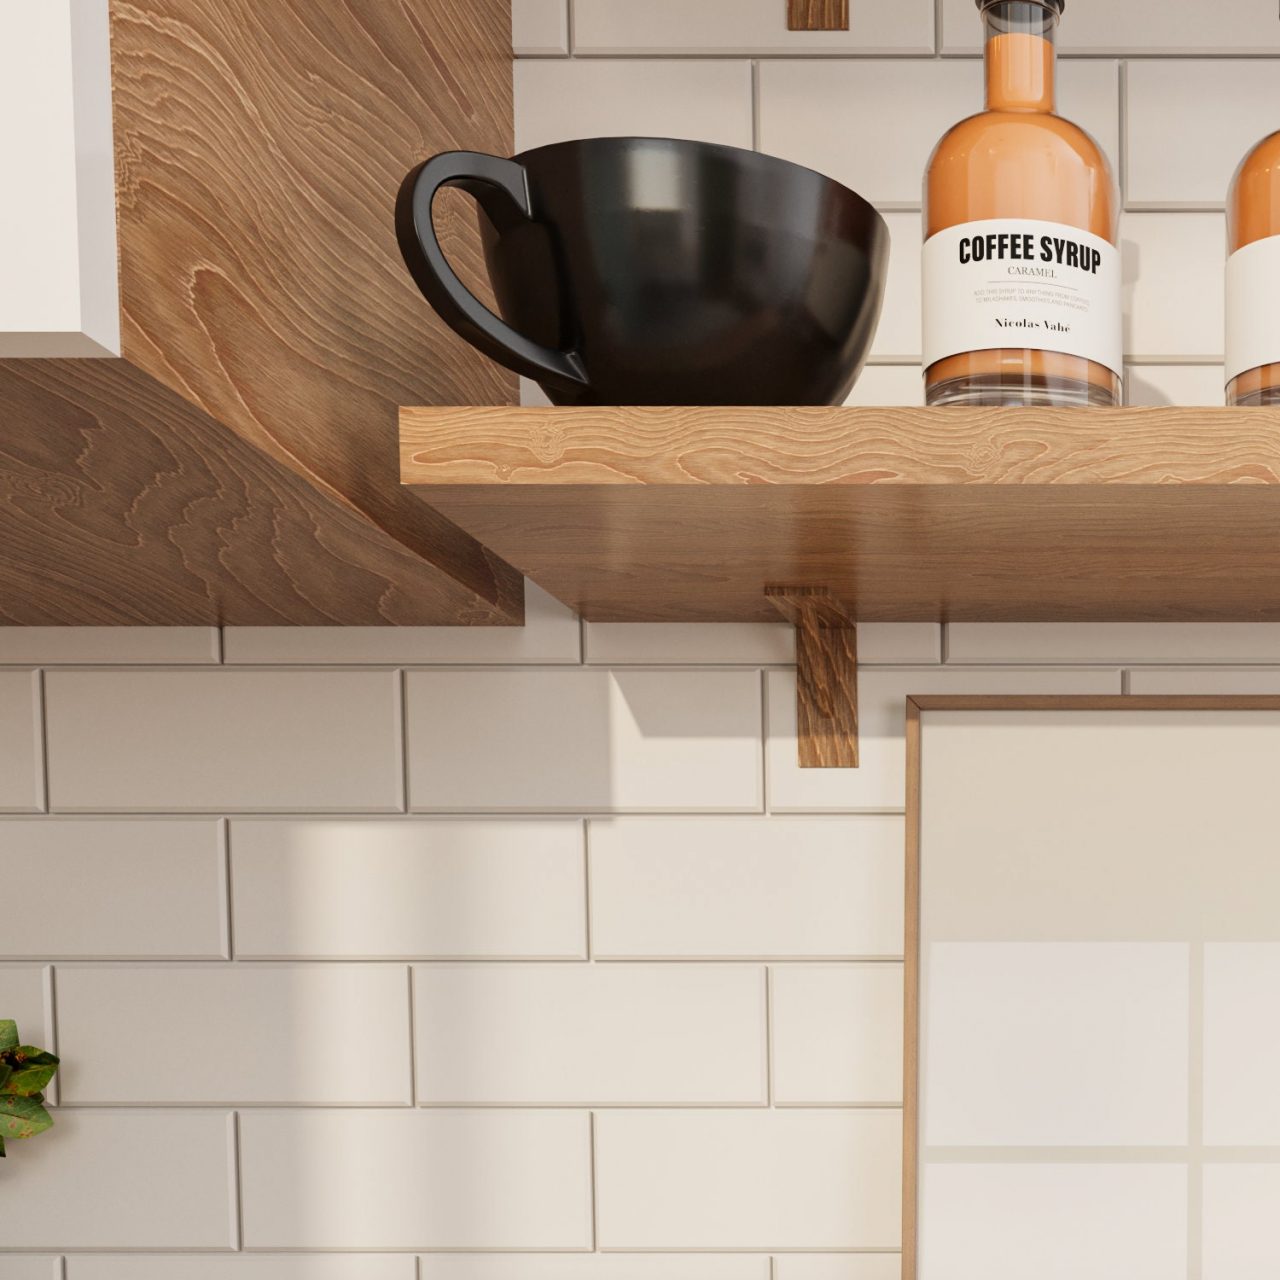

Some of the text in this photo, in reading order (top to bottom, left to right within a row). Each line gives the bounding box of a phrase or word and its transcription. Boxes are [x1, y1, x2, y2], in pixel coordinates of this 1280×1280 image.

[959, 234, 1101, 275] COFFEE SYRUP
[1007, 266, 1057, 279] CARAMEL
[995, 318, 1040, 328] Nicolas
